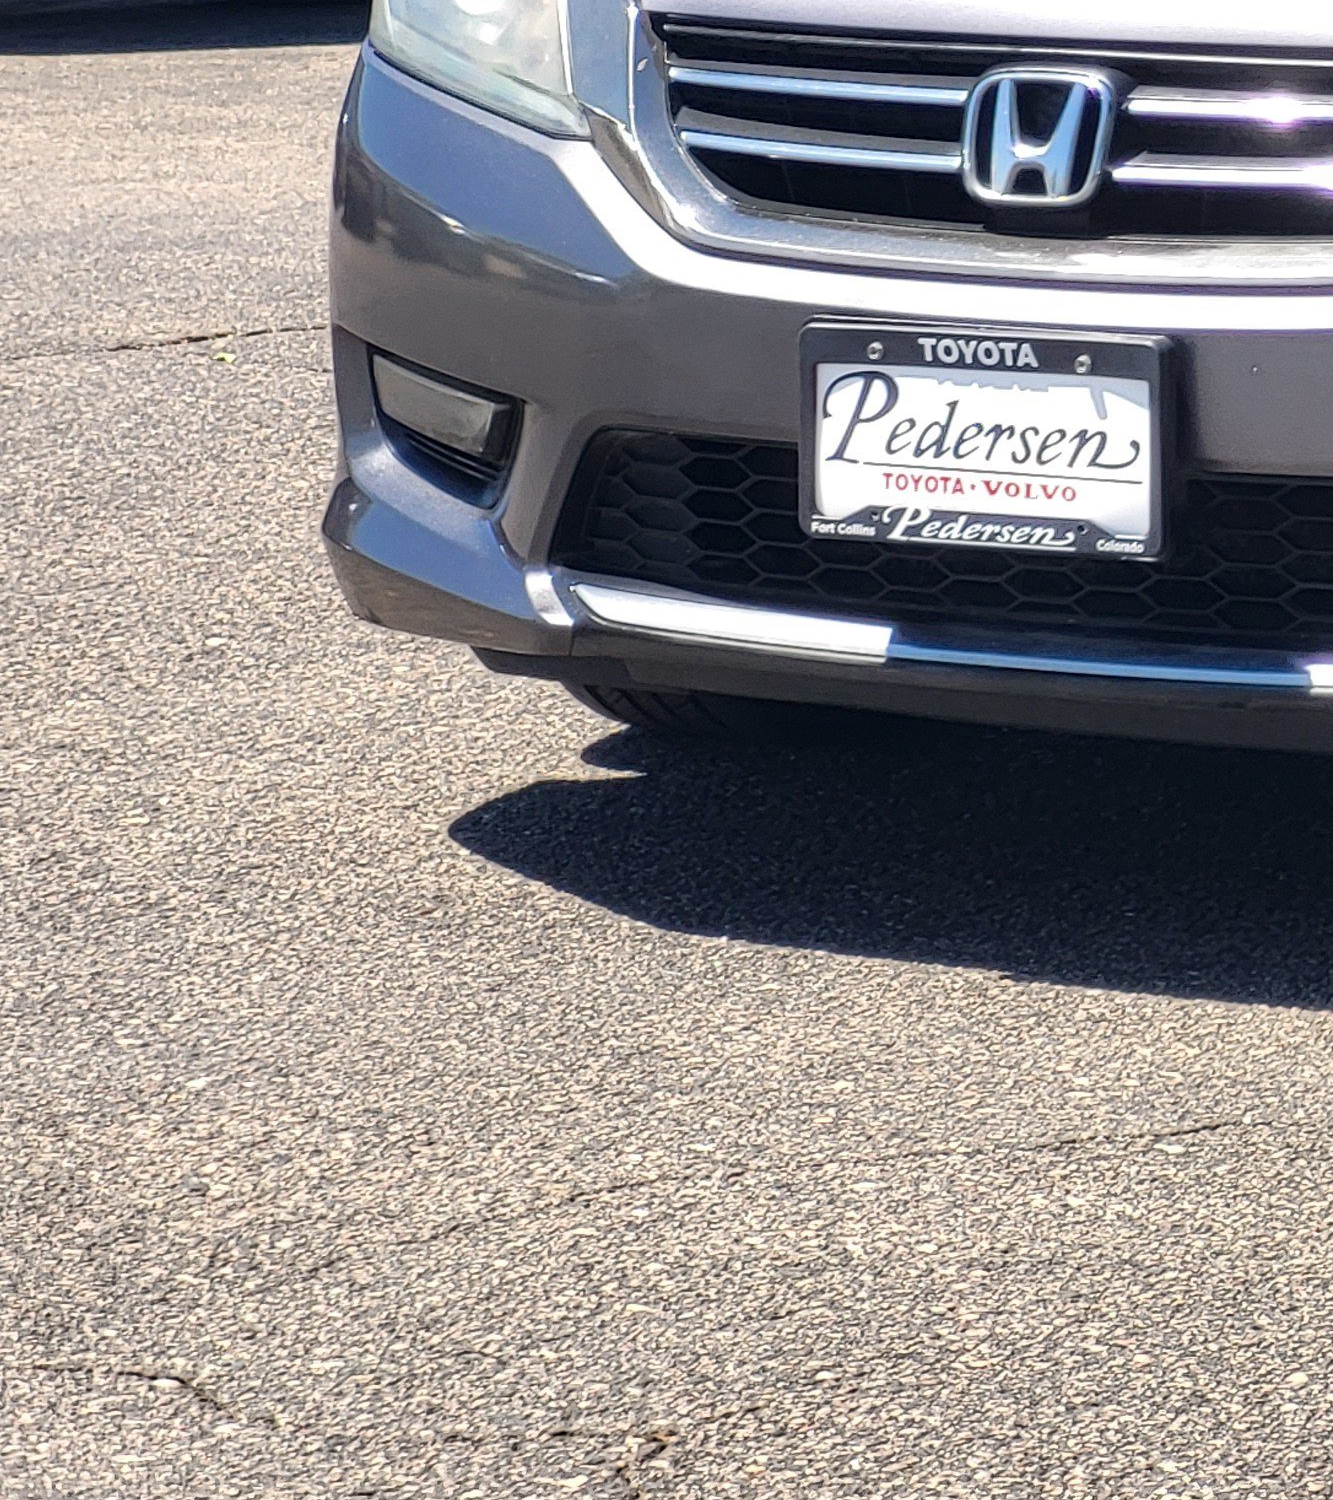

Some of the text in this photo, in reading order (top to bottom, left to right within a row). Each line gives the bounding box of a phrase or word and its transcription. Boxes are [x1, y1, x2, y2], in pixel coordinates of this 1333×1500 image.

[918, 338, 1039, 368] TOYOTA
[823, 370, 1140, 469] Pedersen
[883, 472, 1077, 502] TOYOTA VOLVO
[811, 521, 876, 536] Fort Collins
[882, 505, 1075, 545] Pedersen
[1096, 539, 1145, 554] Colorado
